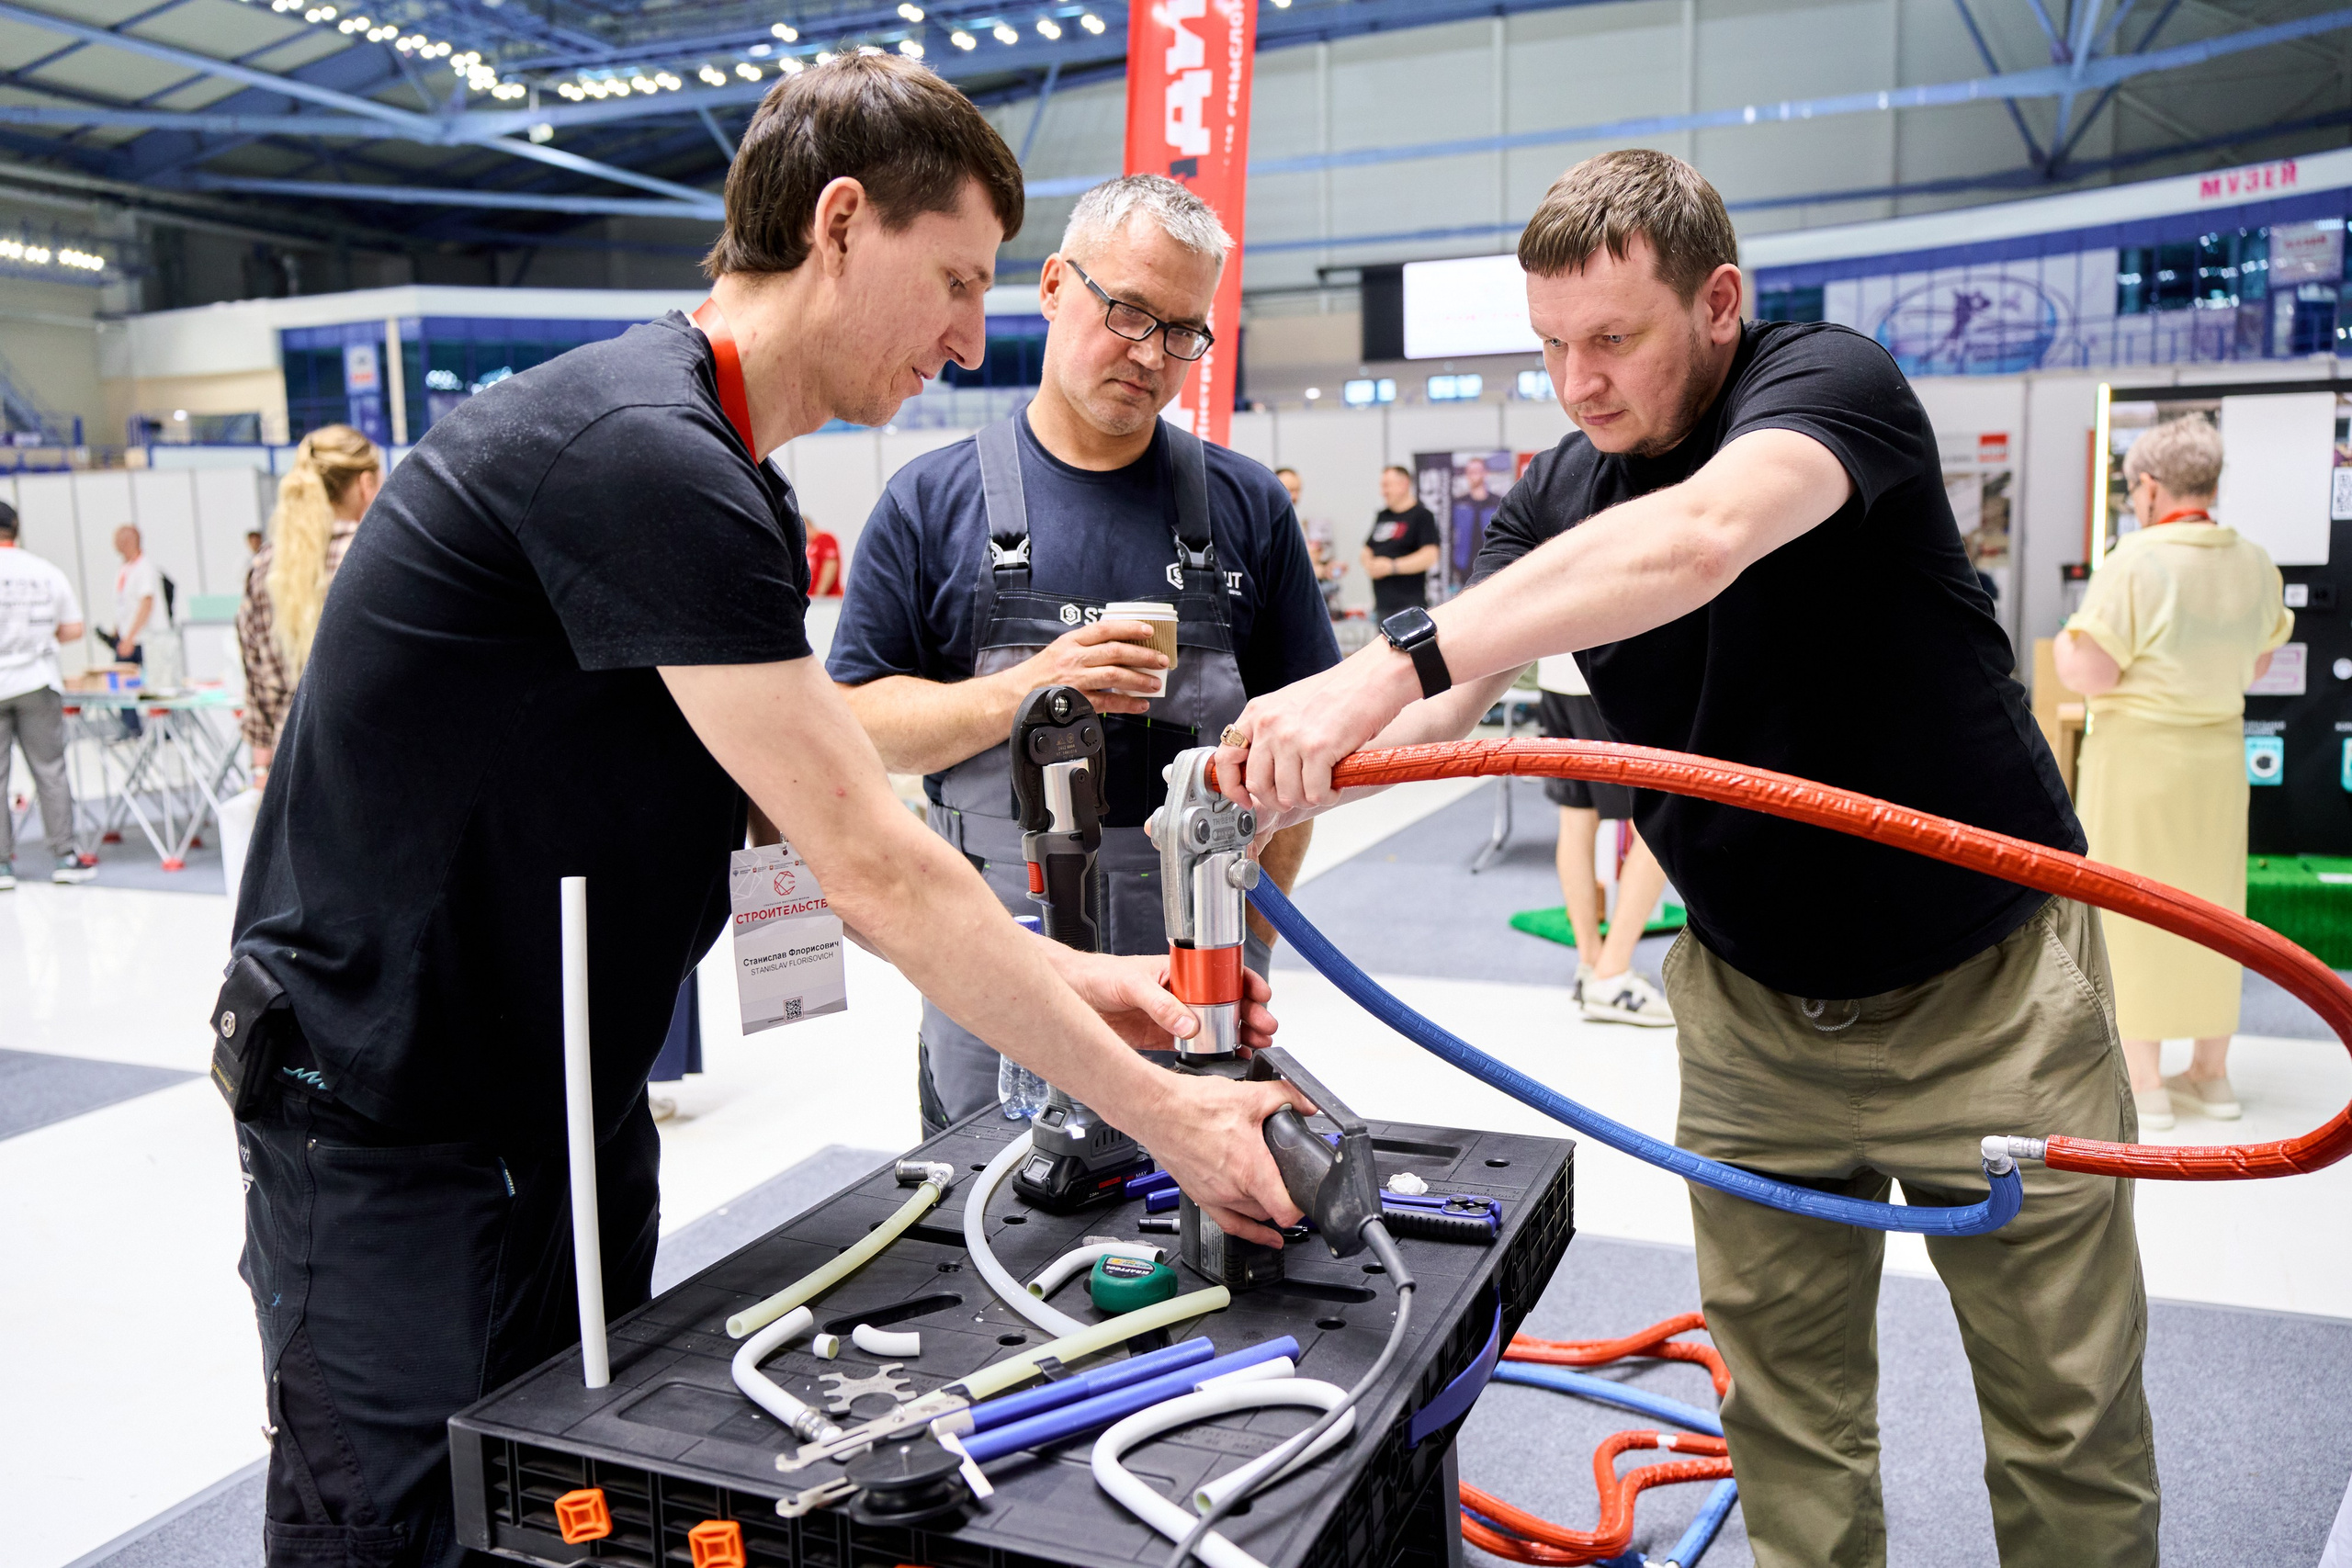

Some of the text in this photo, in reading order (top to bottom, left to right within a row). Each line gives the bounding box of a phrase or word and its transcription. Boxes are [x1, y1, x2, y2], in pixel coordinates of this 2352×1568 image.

[2200, 159, 2296, 198] МУЗЕЙ
[736, 898, 829, 925] СТРОИТЕЛЬСТВ
[743, 941, 840, 967] Станислав Флорисович
[751, 952, 834, 976] STANISLAV FLORISOVICH
